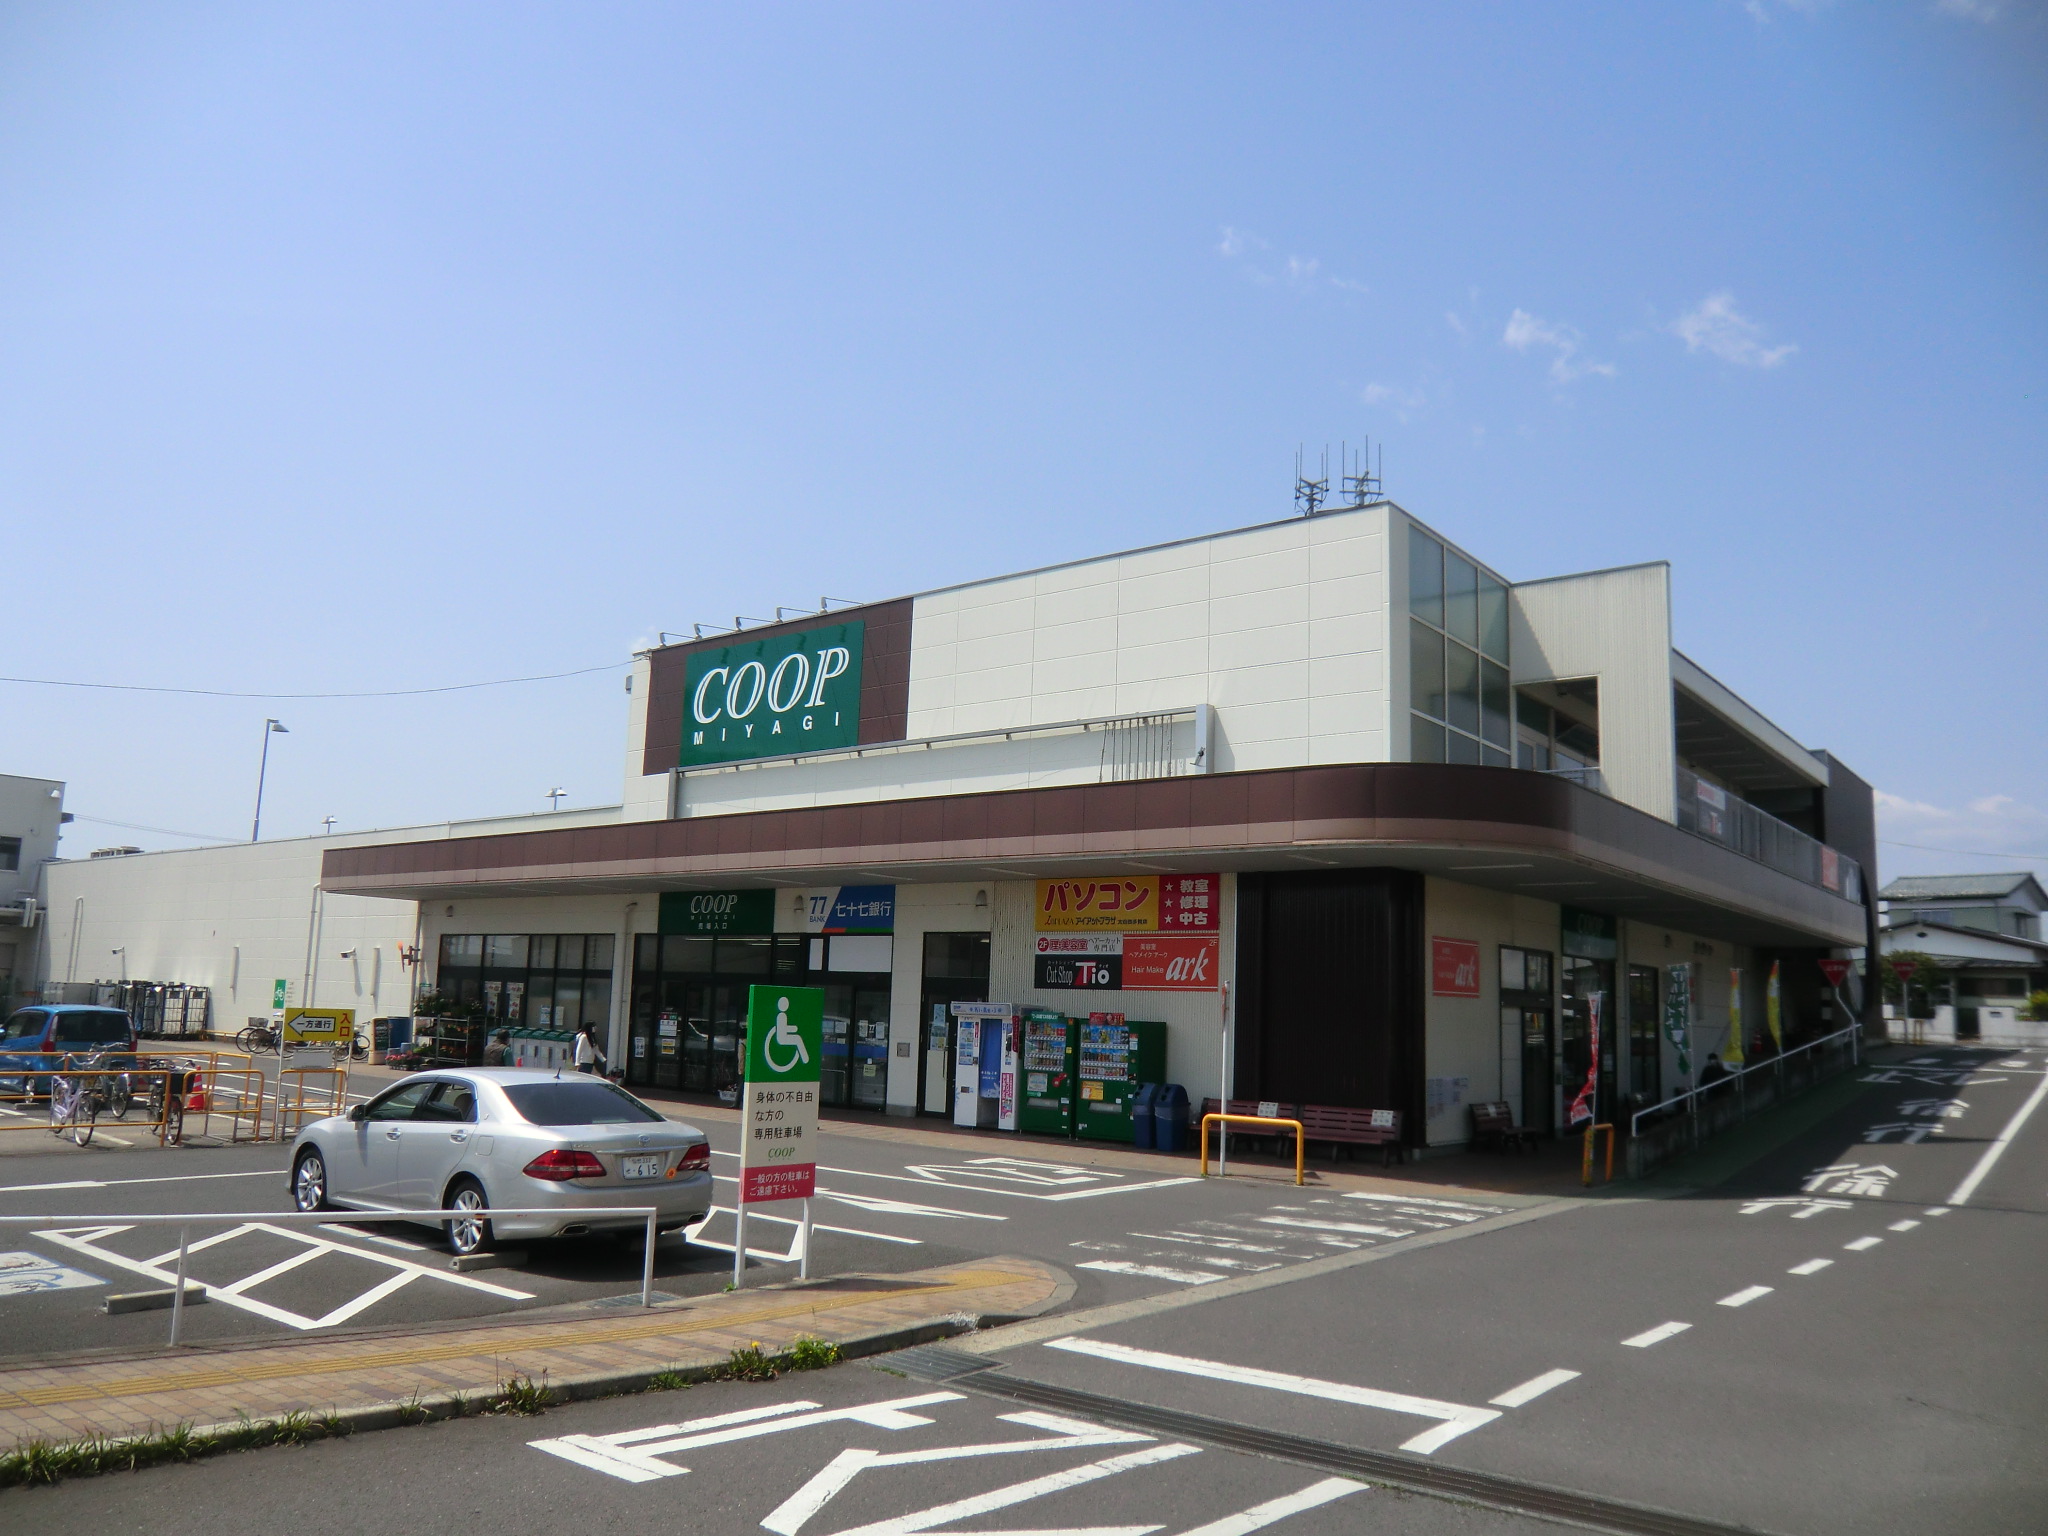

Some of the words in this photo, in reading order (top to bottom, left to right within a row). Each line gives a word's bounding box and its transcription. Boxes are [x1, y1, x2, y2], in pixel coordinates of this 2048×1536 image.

[693, 646, 850, 725] COOP
[693, 711, 839, 746] MIYAGI
[1179, 879, 1209, 893] 教室
[1044, 881, 1150, 912] パソコン
[1179, 895, 1209, 909] 修理
[690, 894, 738, 914] COOP
[809, 896, 828, 915] 77
[835, 901, 891, 917] 七十七銀行
[810, 915, 826, 923] BANK
[1179, 911, 1208, 926] 中古
[1038, 941, 1048, 949] 2F
[1094, 944, 1116, 952] 専門店
[1165, 946, 1209, 982] ark
[1046, 966, 1058, 983] Cut
[1058, 966, 1073, 986] Shop
[1075, 962, 1110, 985] Tio
[1455, 955, 1475, 988] ark
[297, 1020, 332, 1029] 一方通行
[339, 1012, 351, 1037] 入口
[755, 1090, 813, 1104] 身体の不自由
[755, 1109, 784, 1121] な方の
[754, 1126, 803, 1140] 専用駐車場
[768, 1148, 795, 1157] COOP
[749, 1170, 810, 1183] 一般の方の駐車は
[749, 1184, 798, 1197] ご遠慮下さい。
